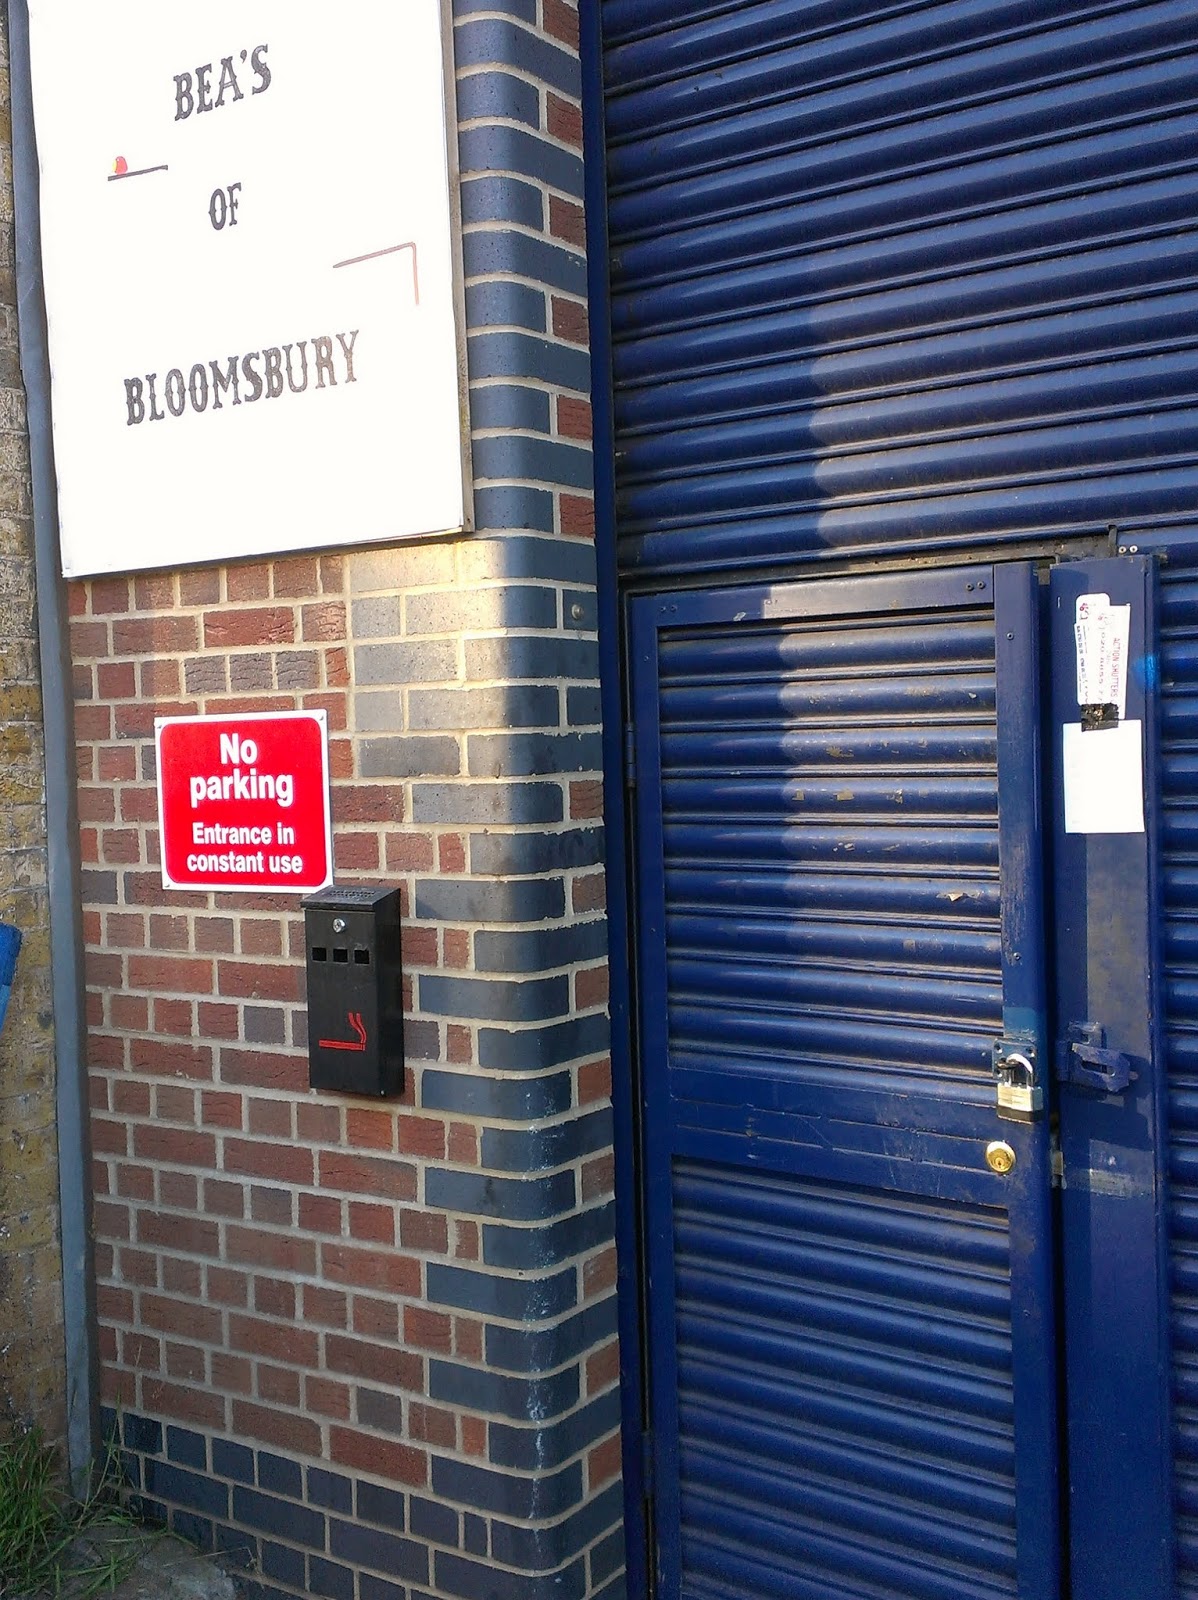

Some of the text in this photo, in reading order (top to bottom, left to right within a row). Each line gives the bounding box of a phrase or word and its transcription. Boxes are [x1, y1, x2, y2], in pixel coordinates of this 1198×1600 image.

[173, 44, 272, 121] BEA'S
[208, 182, 242, 230] OF
[124, 330, 359, 426] BLOOMSBURY
[1110, 637, 1121, 698] ACTION SHUTTERS
[219, 732, 258, 765] No
[189, 768, 294, 808] parking
[192, 821, 295, 845] Entrance in
[186, 851, 304, 875] constant use
